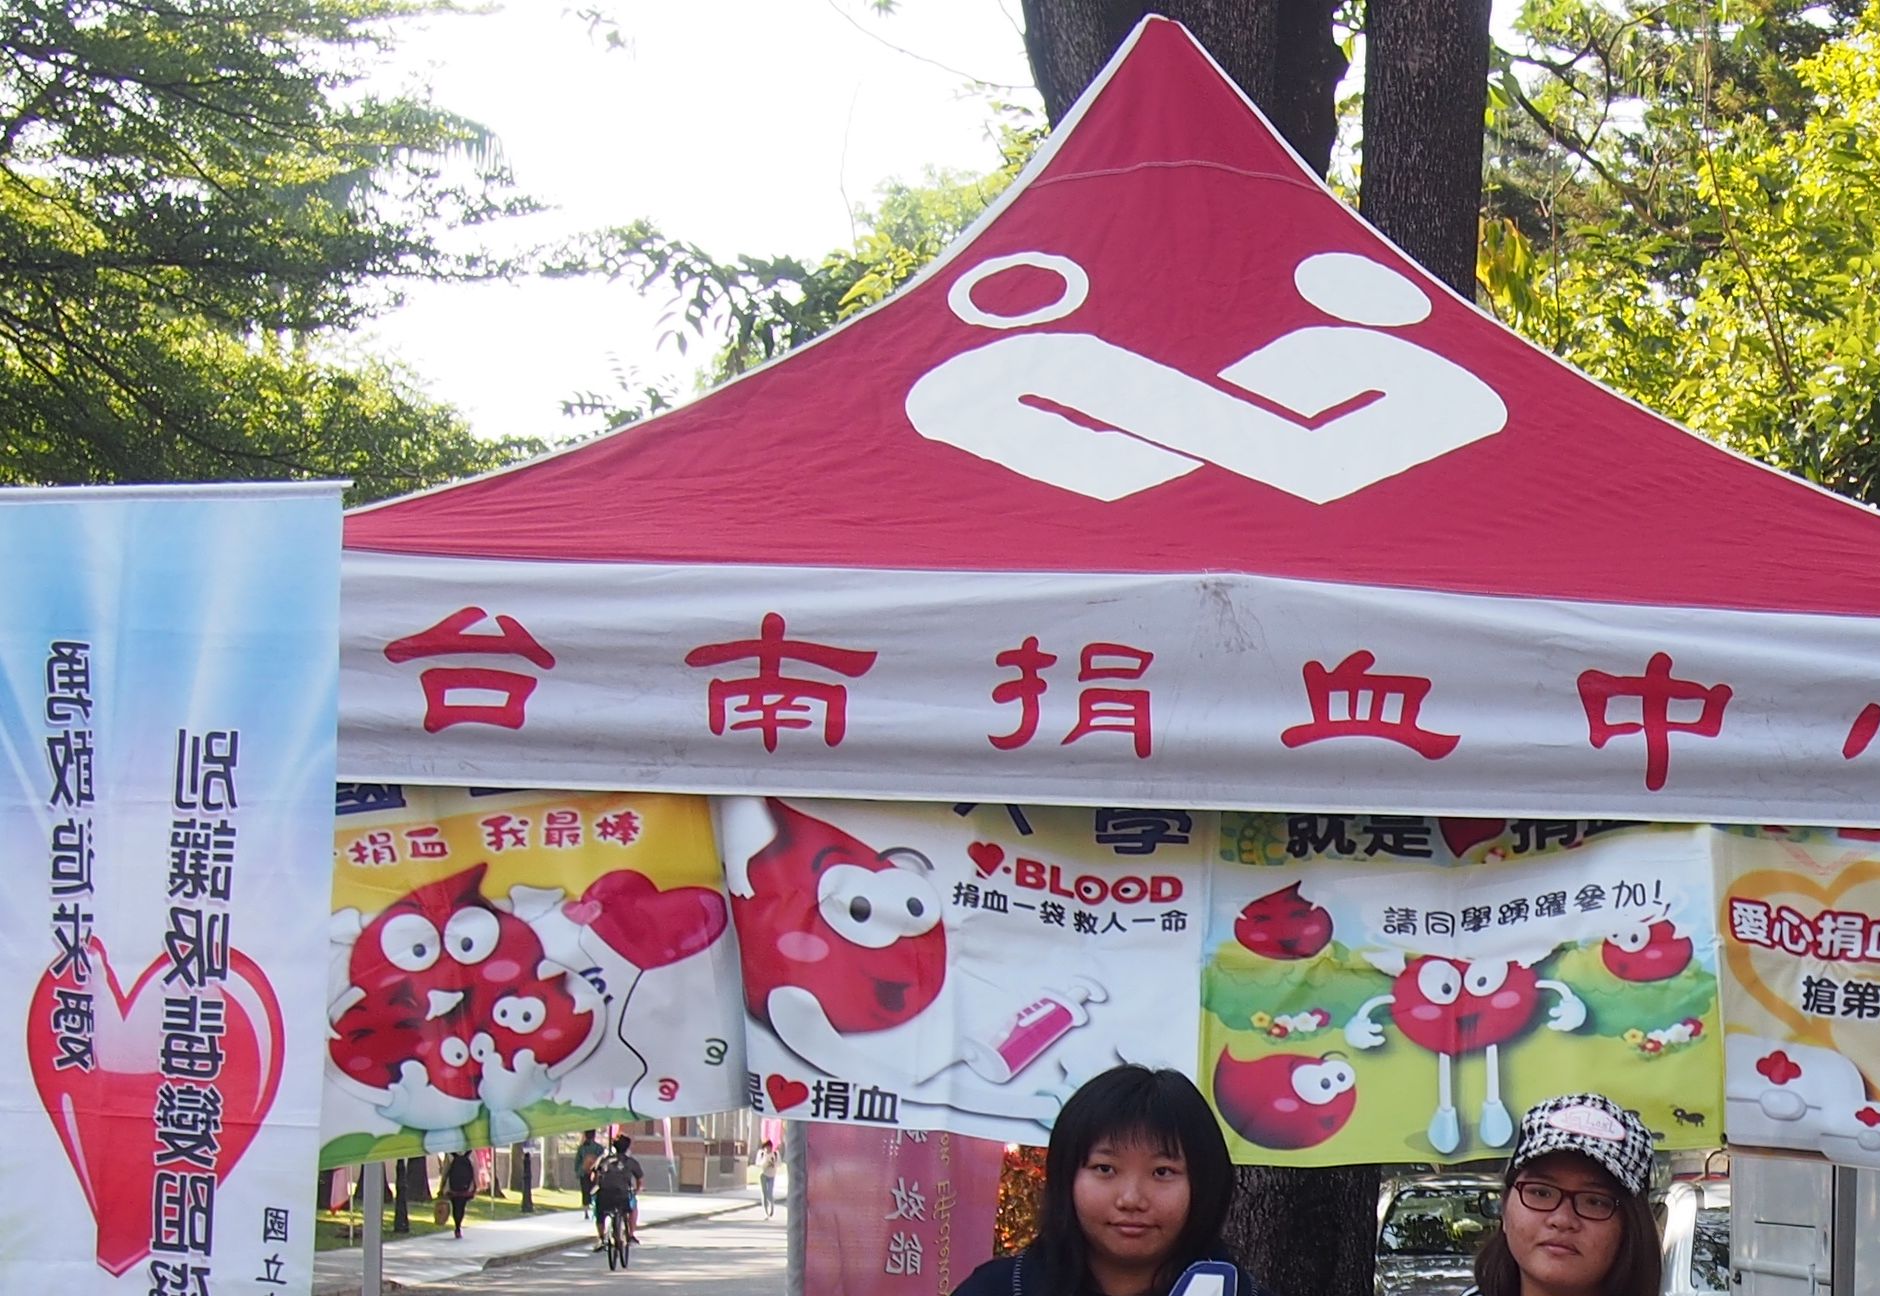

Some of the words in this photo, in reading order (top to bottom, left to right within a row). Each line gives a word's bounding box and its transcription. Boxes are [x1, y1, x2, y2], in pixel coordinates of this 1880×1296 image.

[348, 827, 449, 865] 捐血
[481, 811, 641, 852] 我最棒
[952, 881, 1067, 928] 捐血一袋
[1073, 910, 1188, 936] 救人一命
[811, 1080, 899, 1124] 捐血
